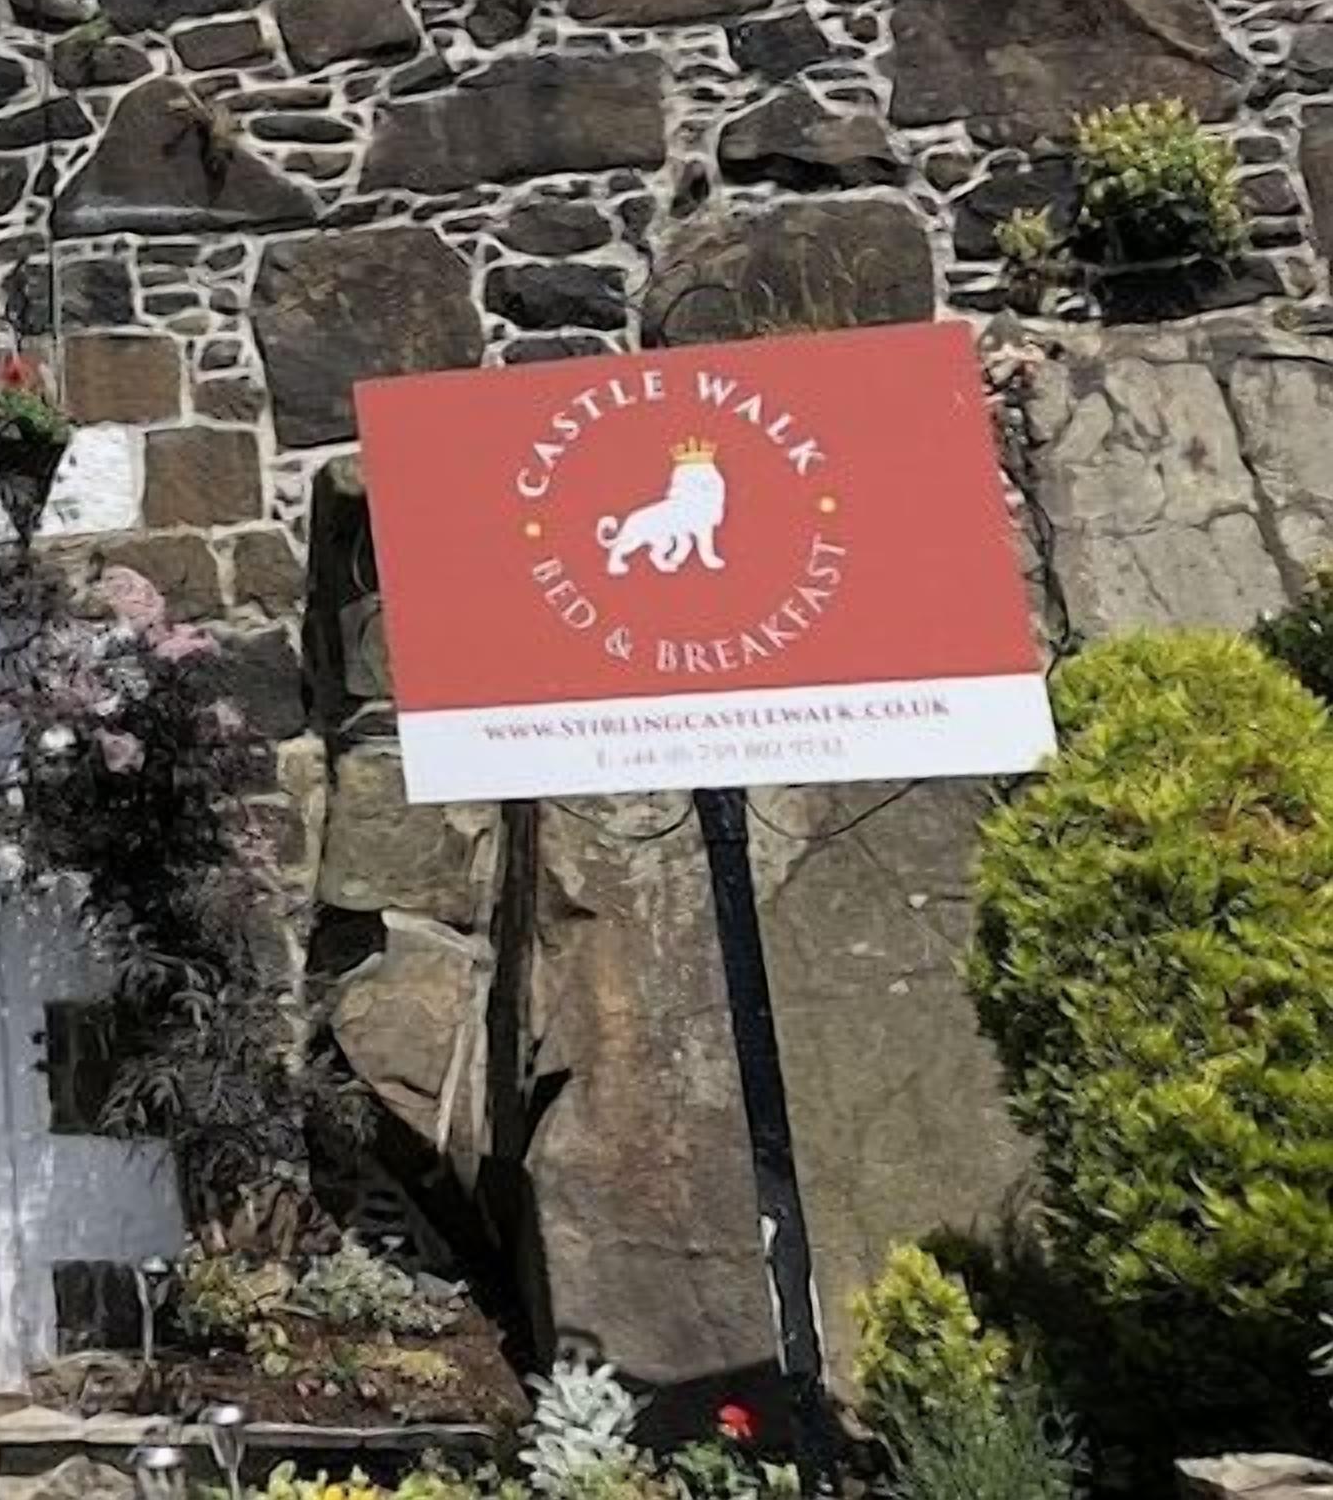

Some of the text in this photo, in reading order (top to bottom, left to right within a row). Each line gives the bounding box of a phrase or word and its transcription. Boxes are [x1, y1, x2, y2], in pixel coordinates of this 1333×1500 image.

[517, 371, 827, 497] CASTLE WALK
[532, 534, 846, 672] BED & BREAKFAST
[485, 696, 950, 741] WWW.STIRLINGCASTLEWALK.CO.UK
